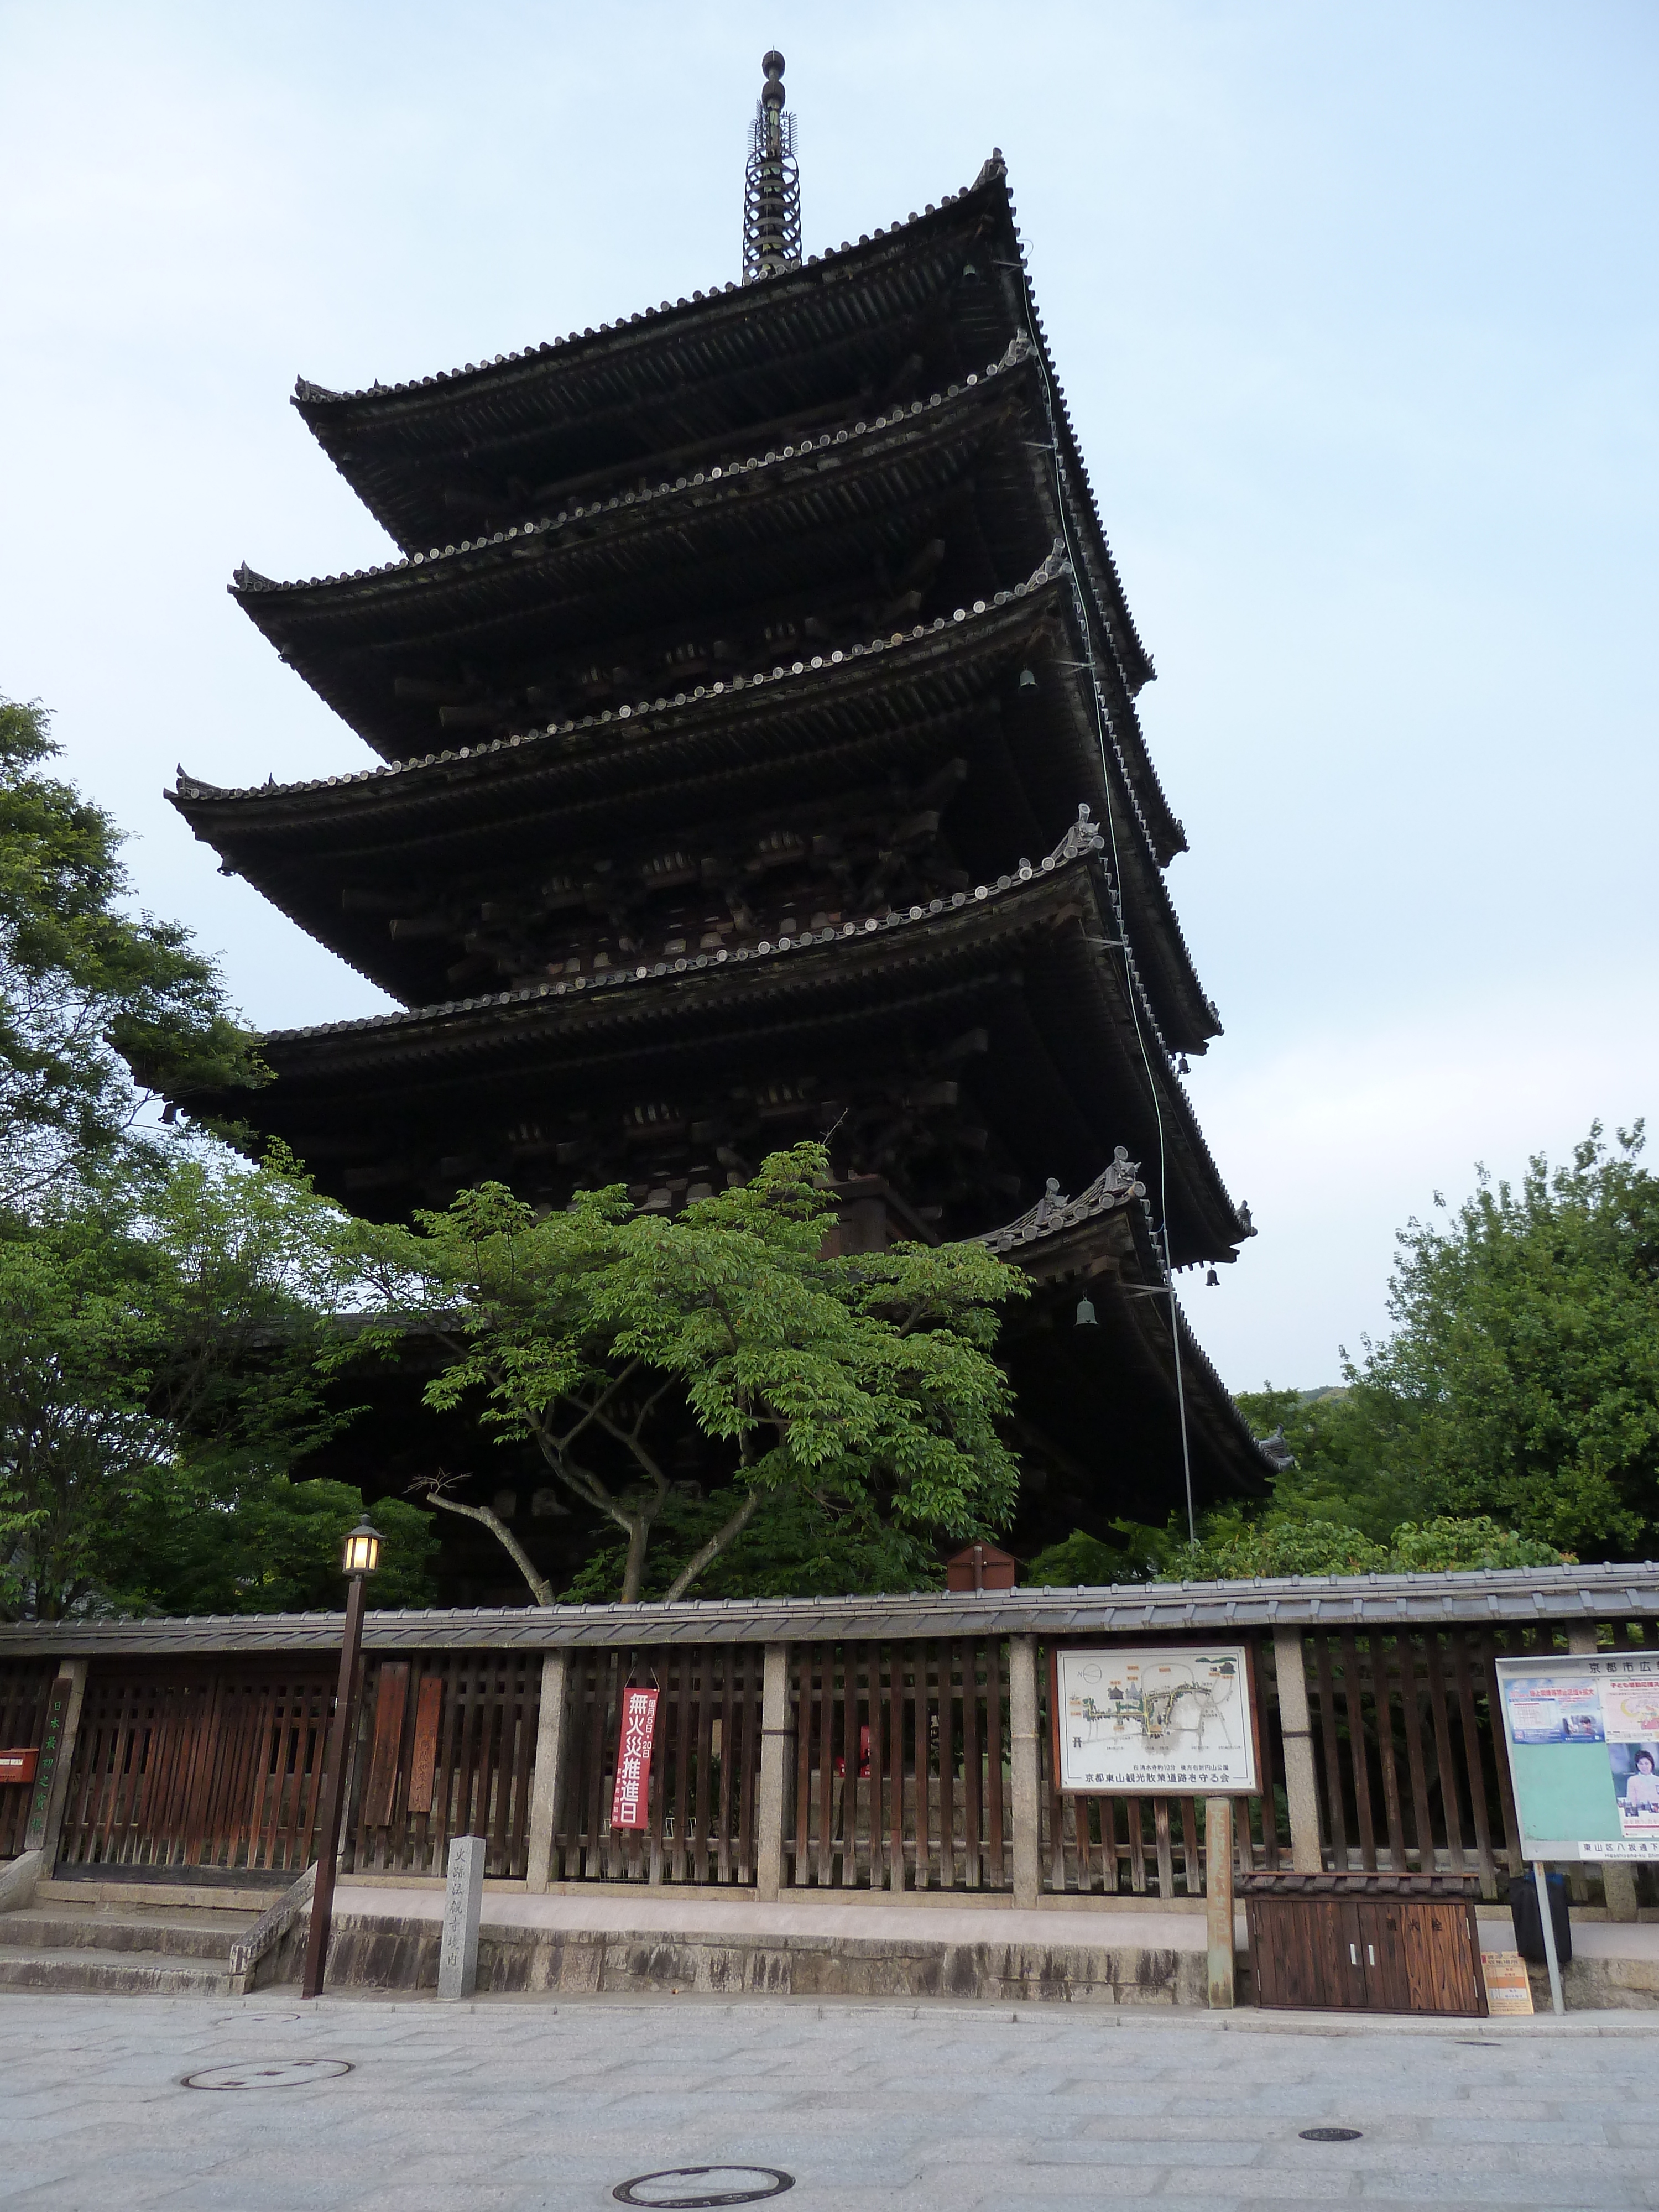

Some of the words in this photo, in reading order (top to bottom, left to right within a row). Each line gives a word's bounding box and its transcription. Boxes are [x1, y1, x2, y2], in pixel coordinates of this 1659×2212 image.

[620, 1693, 648, 1824] 無火災推進日
[642, 1699, 656, 1759] 毎月5日・20日
[1084, 1773, 1230, 1783] 京都東山観光散策道路を守る会
[448, 1848, 466, 1967] 史跡法観寺境内
